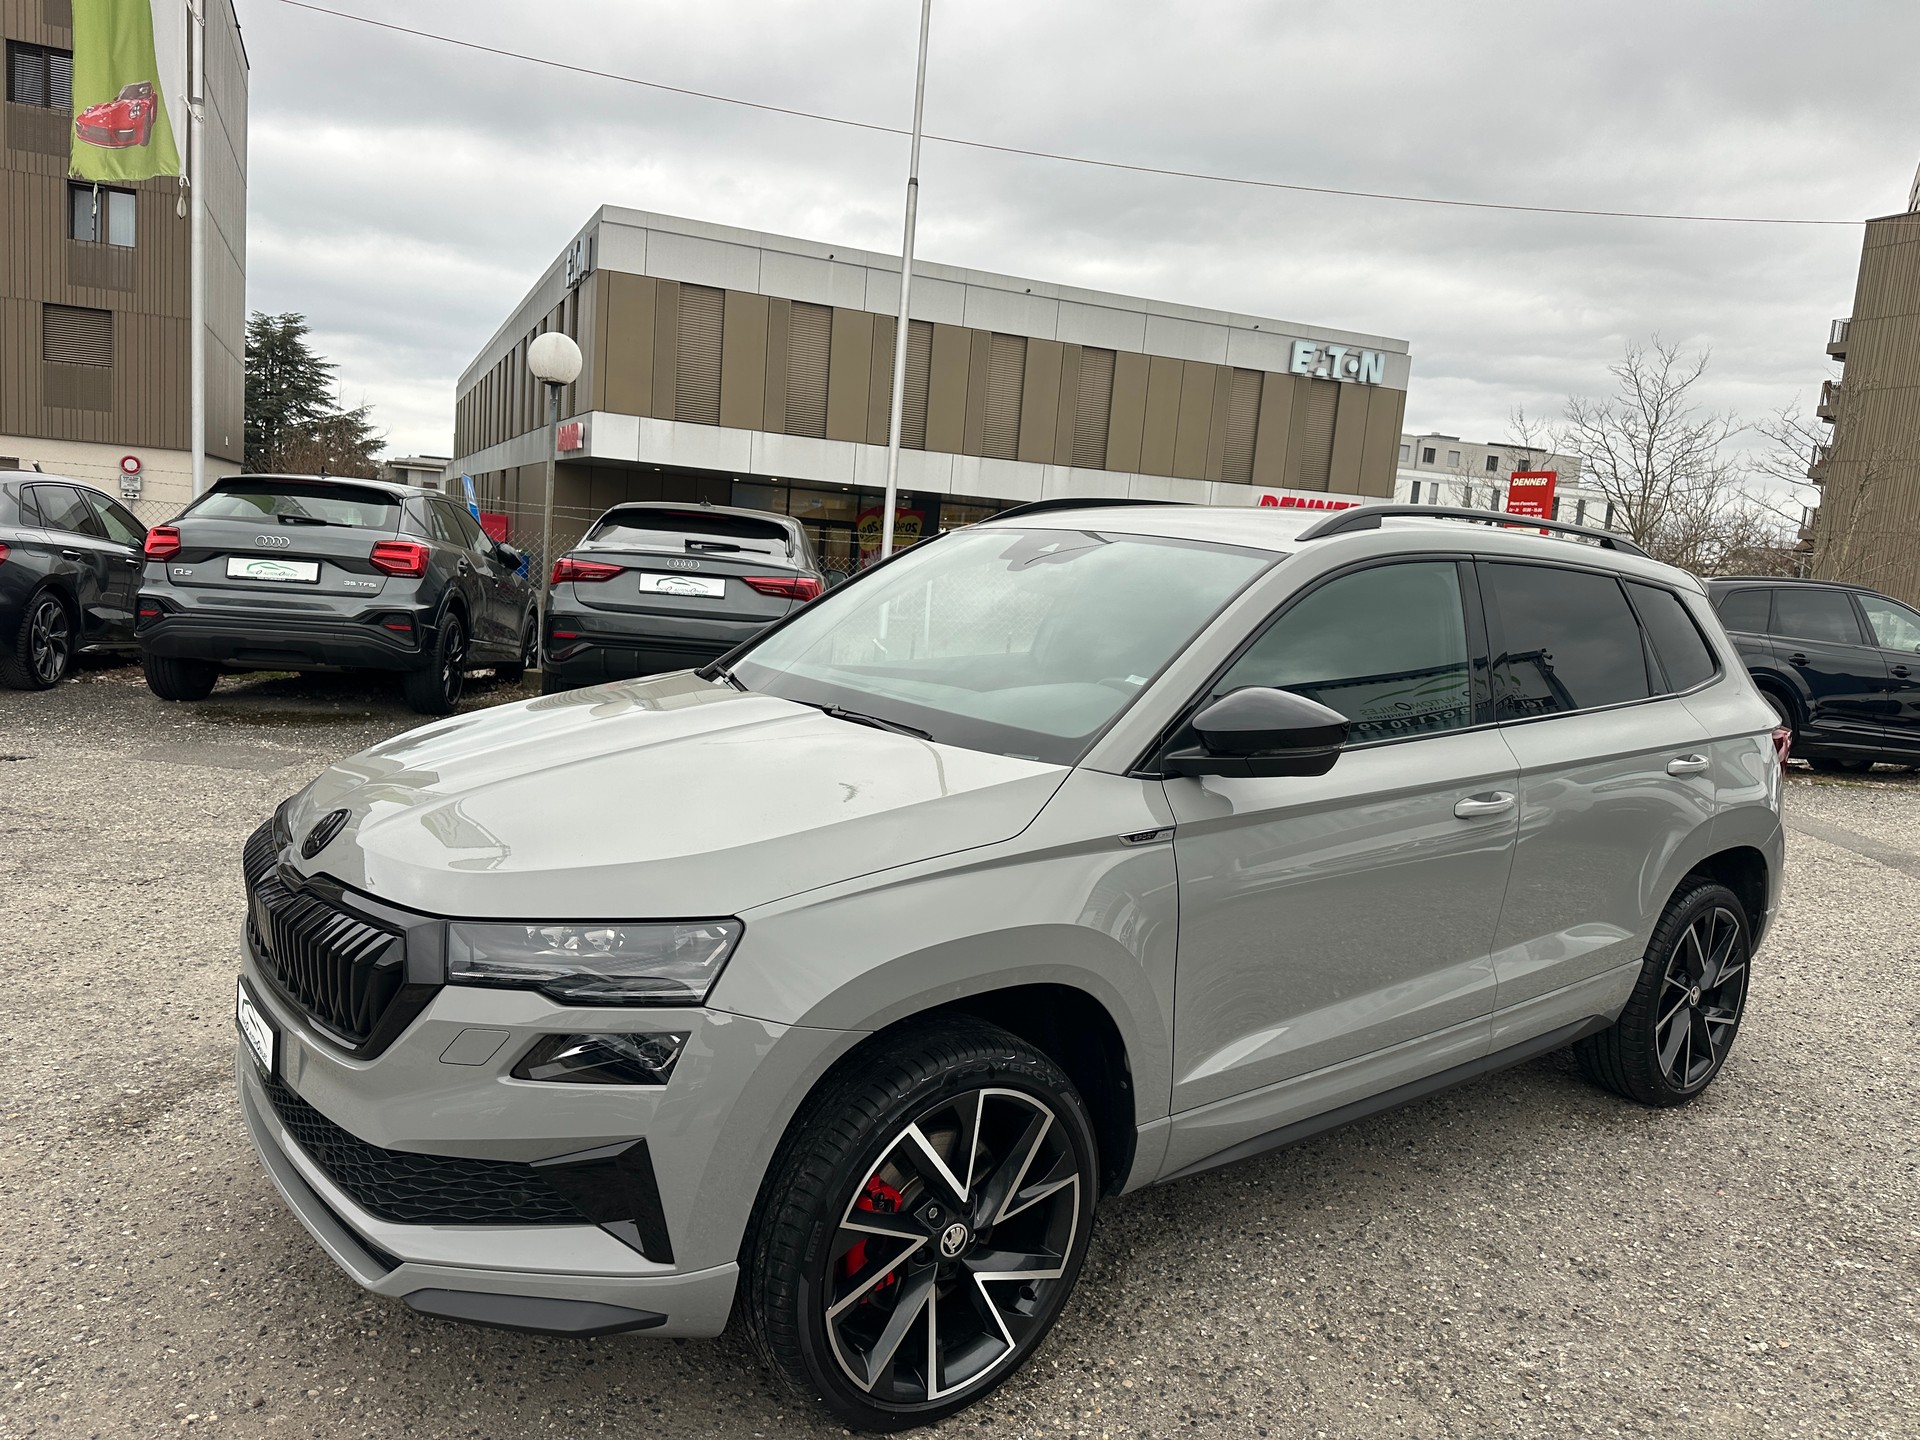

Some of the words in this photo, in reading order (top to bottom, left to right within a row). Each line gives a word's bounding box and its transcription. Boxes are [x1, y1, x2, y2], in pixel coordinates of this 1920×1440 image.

[1290, 339, 1386, 385] EATON
[1512, 477, 1548, 486] DENNER
[173, 568, 193, 576] Q2
